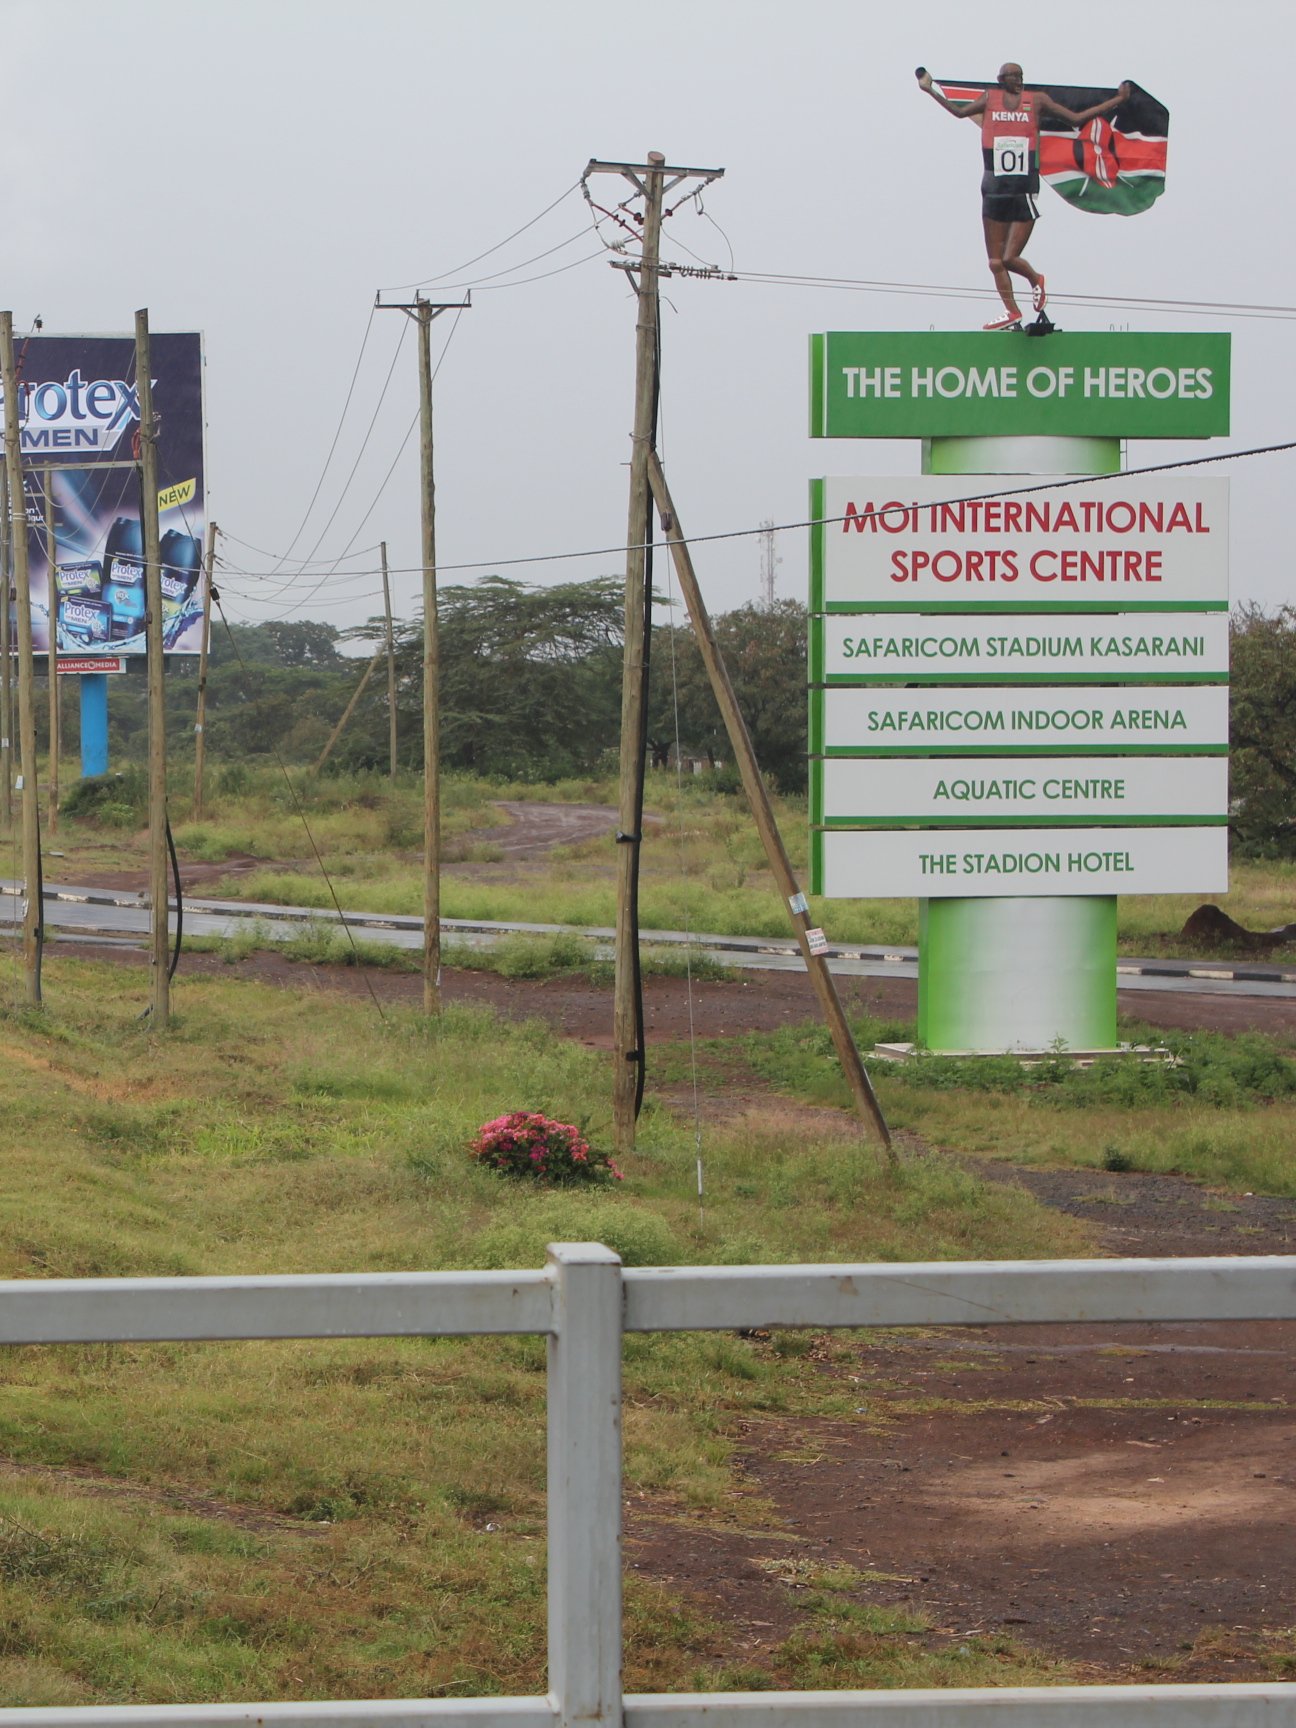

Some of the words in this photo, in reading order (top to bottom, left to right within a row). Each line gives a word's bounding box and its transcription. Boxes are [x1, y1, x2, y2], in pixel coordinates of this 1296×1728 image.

[992, 111, 1029, 122] KENYA
[997, 141, 1024, 149] Safaricom
[1001, 150, 1024, 172] 01
[843, 366, 902, 398] THE
[911, 366, 1018, 398] HOME
[1026, 366, 1074, 399] OF
[1083, 366, 1213, 399] HEROES
[21, 428, 99, 448] MEN
[159, 485, 191, 507] NEW
[843, 501, 919, 534] MOI
[931, 501, 1210, 534] INTERNATIONAL
[60, 569, 90, 582] Protex
[111, 562, 142, 578] Protex
[890, 550, 1019, 583] SPORTS
[1029, 550, 1163, 582] CENTRE
[65, 603, 96, 620] Protex
[843, 636, 981, 658] SAFARICOM
[987, 636, 1084, 658] STADIUM
[1091, 636, 1205, 657] KASARANI
[868, 709, 1005, 731] SAFARICOM
[1012, 709, 1104, 731] INDOOR
[1111, 709, 1187, 730] ARENA
[934, 778, 1037, 800] AQUATIC
[1044, 778, 1126, 800] CENTRE
[920, 853, 958, 874] THE
[963, 852, 1062, 874] STADION
[1069, 851, 1135, 872] HOTEL
